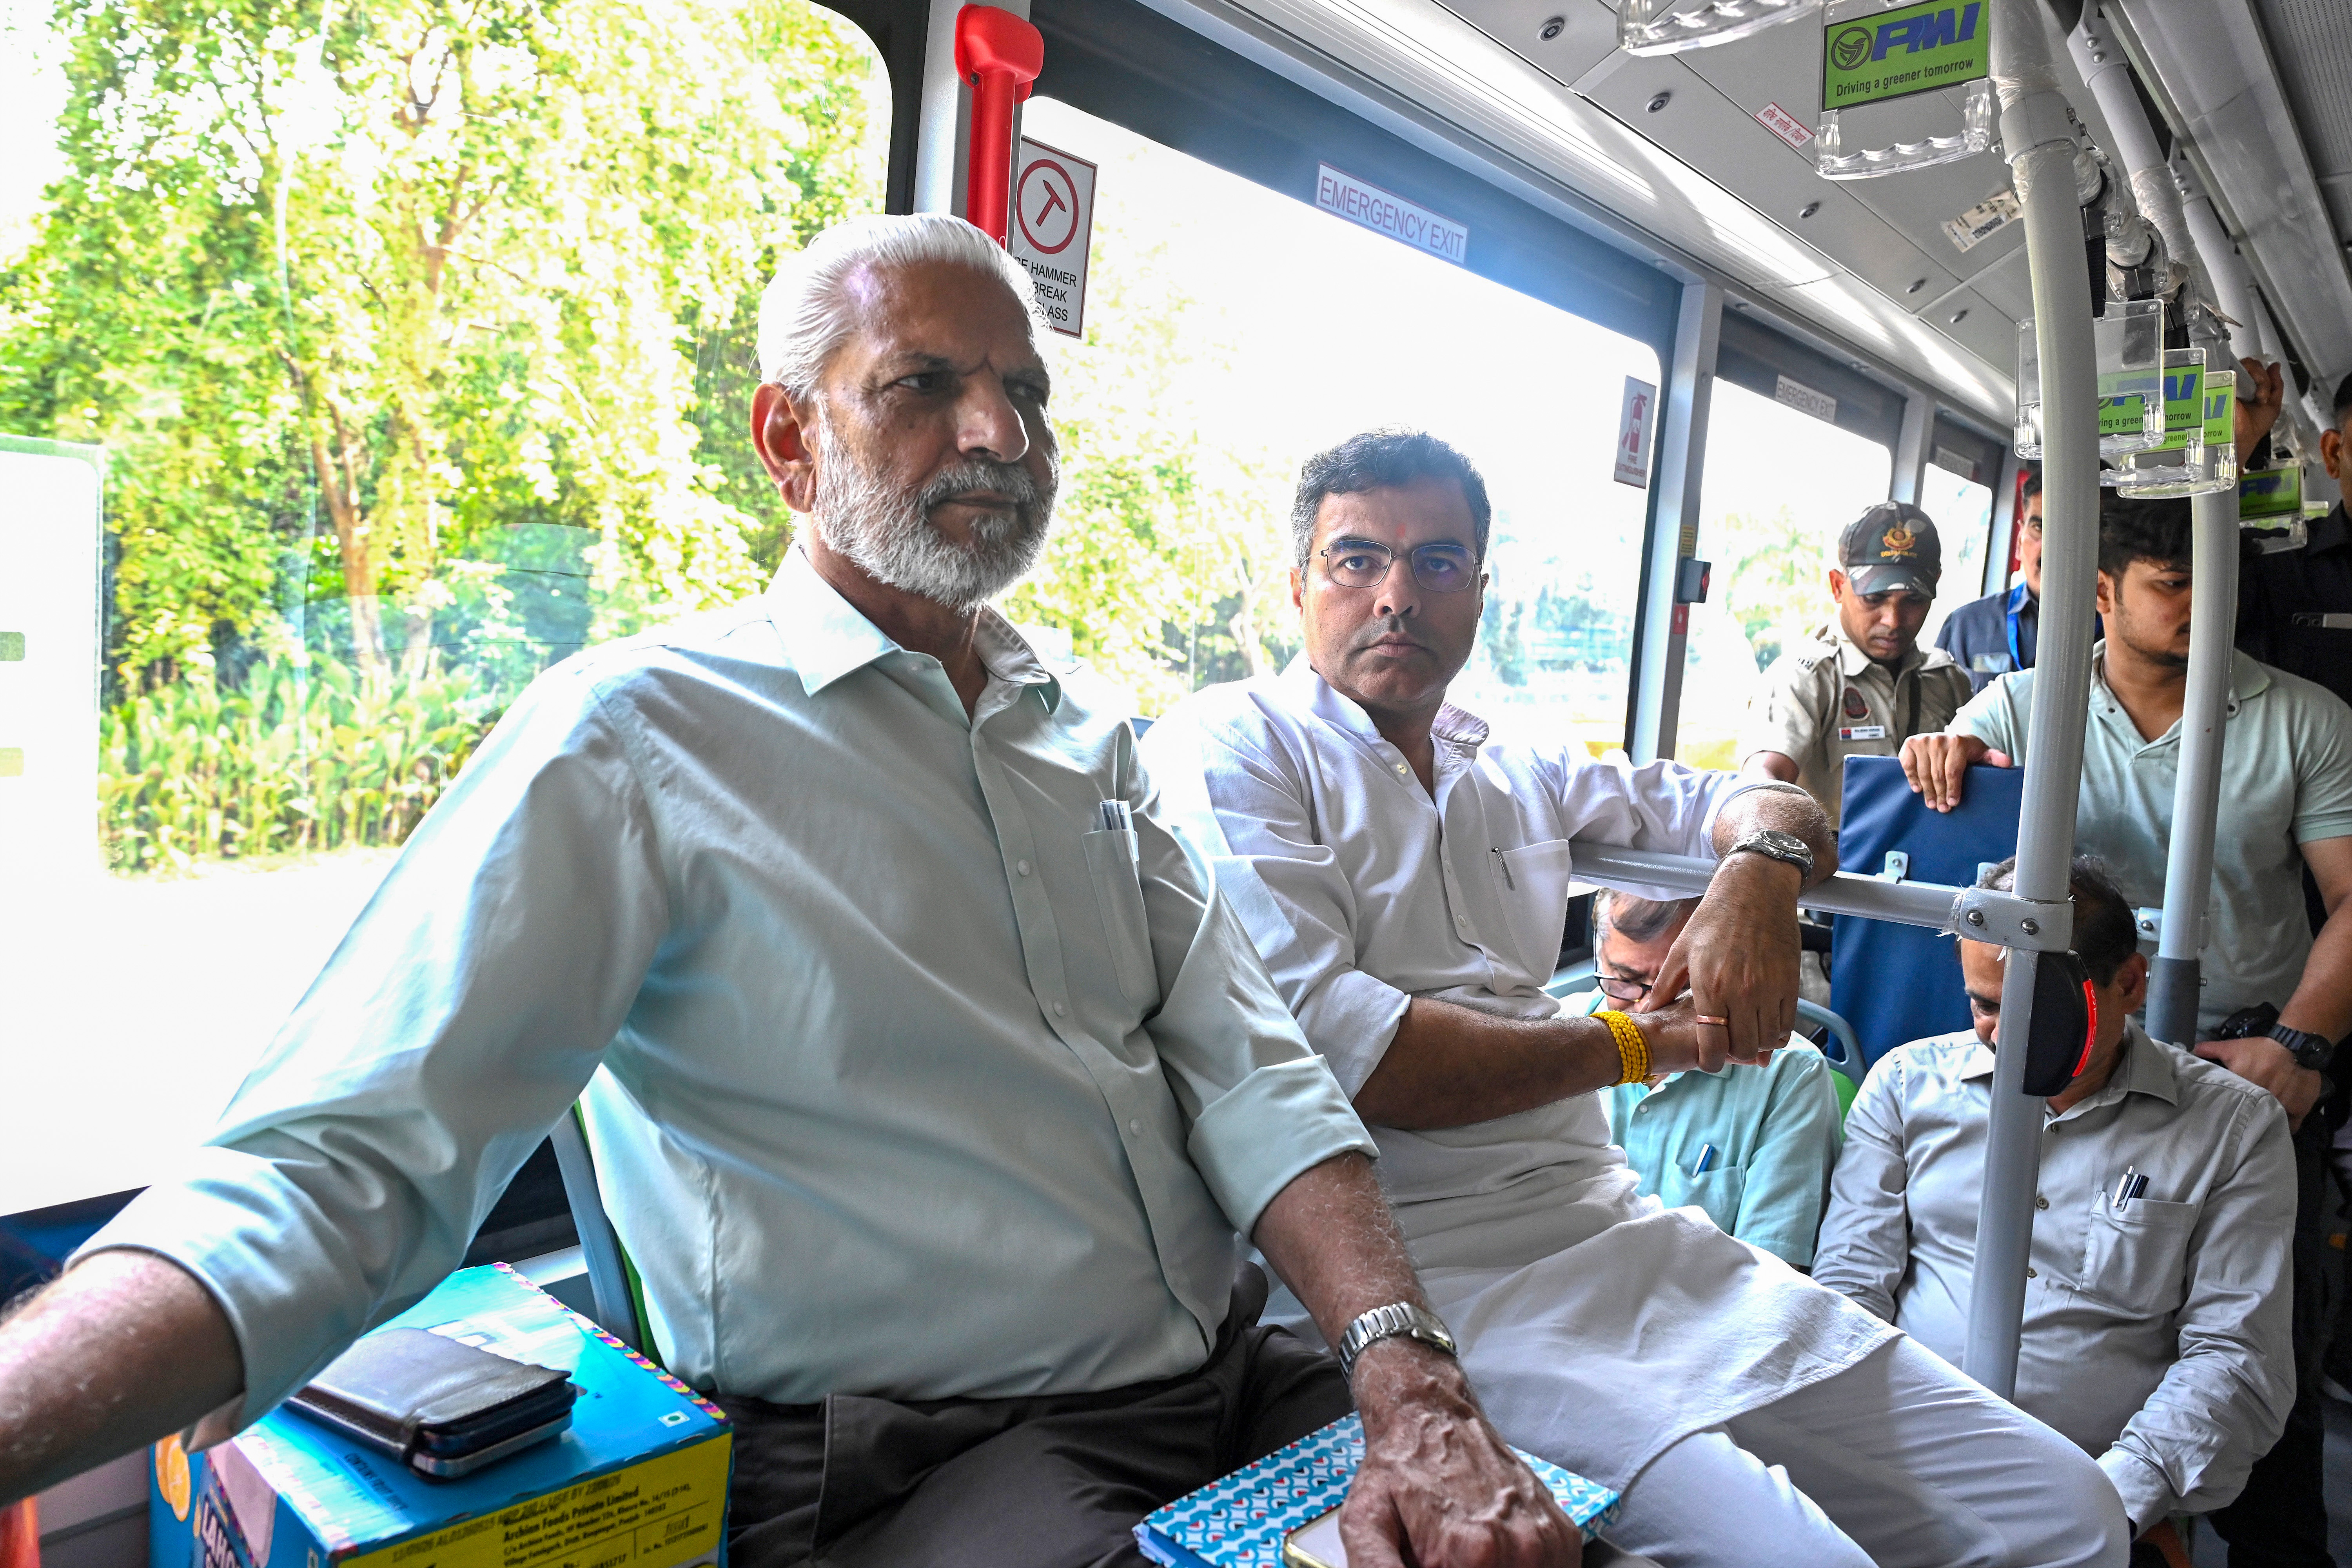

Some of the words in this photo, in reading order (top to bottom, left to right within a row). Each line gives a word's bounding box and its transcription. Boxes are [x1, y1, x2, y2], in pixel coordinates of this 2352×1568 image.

[1871, 2, 1980, 62] PMI
[1837, 80, 1871, 97] Driving
[1883, 70, 1921, 89] greener
[1924, 58, 1973, 78] tomorrow
[1319, 175, 1427, 243] EMERGENCY
[1430, 224, 1463, 258] EXIT
[1031, 261, 1076, 287] HAMMER
[1033, 281, 1067, 303] BREAK
[1778, 381, 1818, 411] EMERGENCY
[1820, 399, 1834, 417] EXIT
[2122, 416, 2143, 427] green
[1628, 454, 1638, 465] FIRE
[543, 1513, 569, 1529] Foods
[572, 1501, 604, 1519] Private
[607, 1485, 639, 1506] Limited
